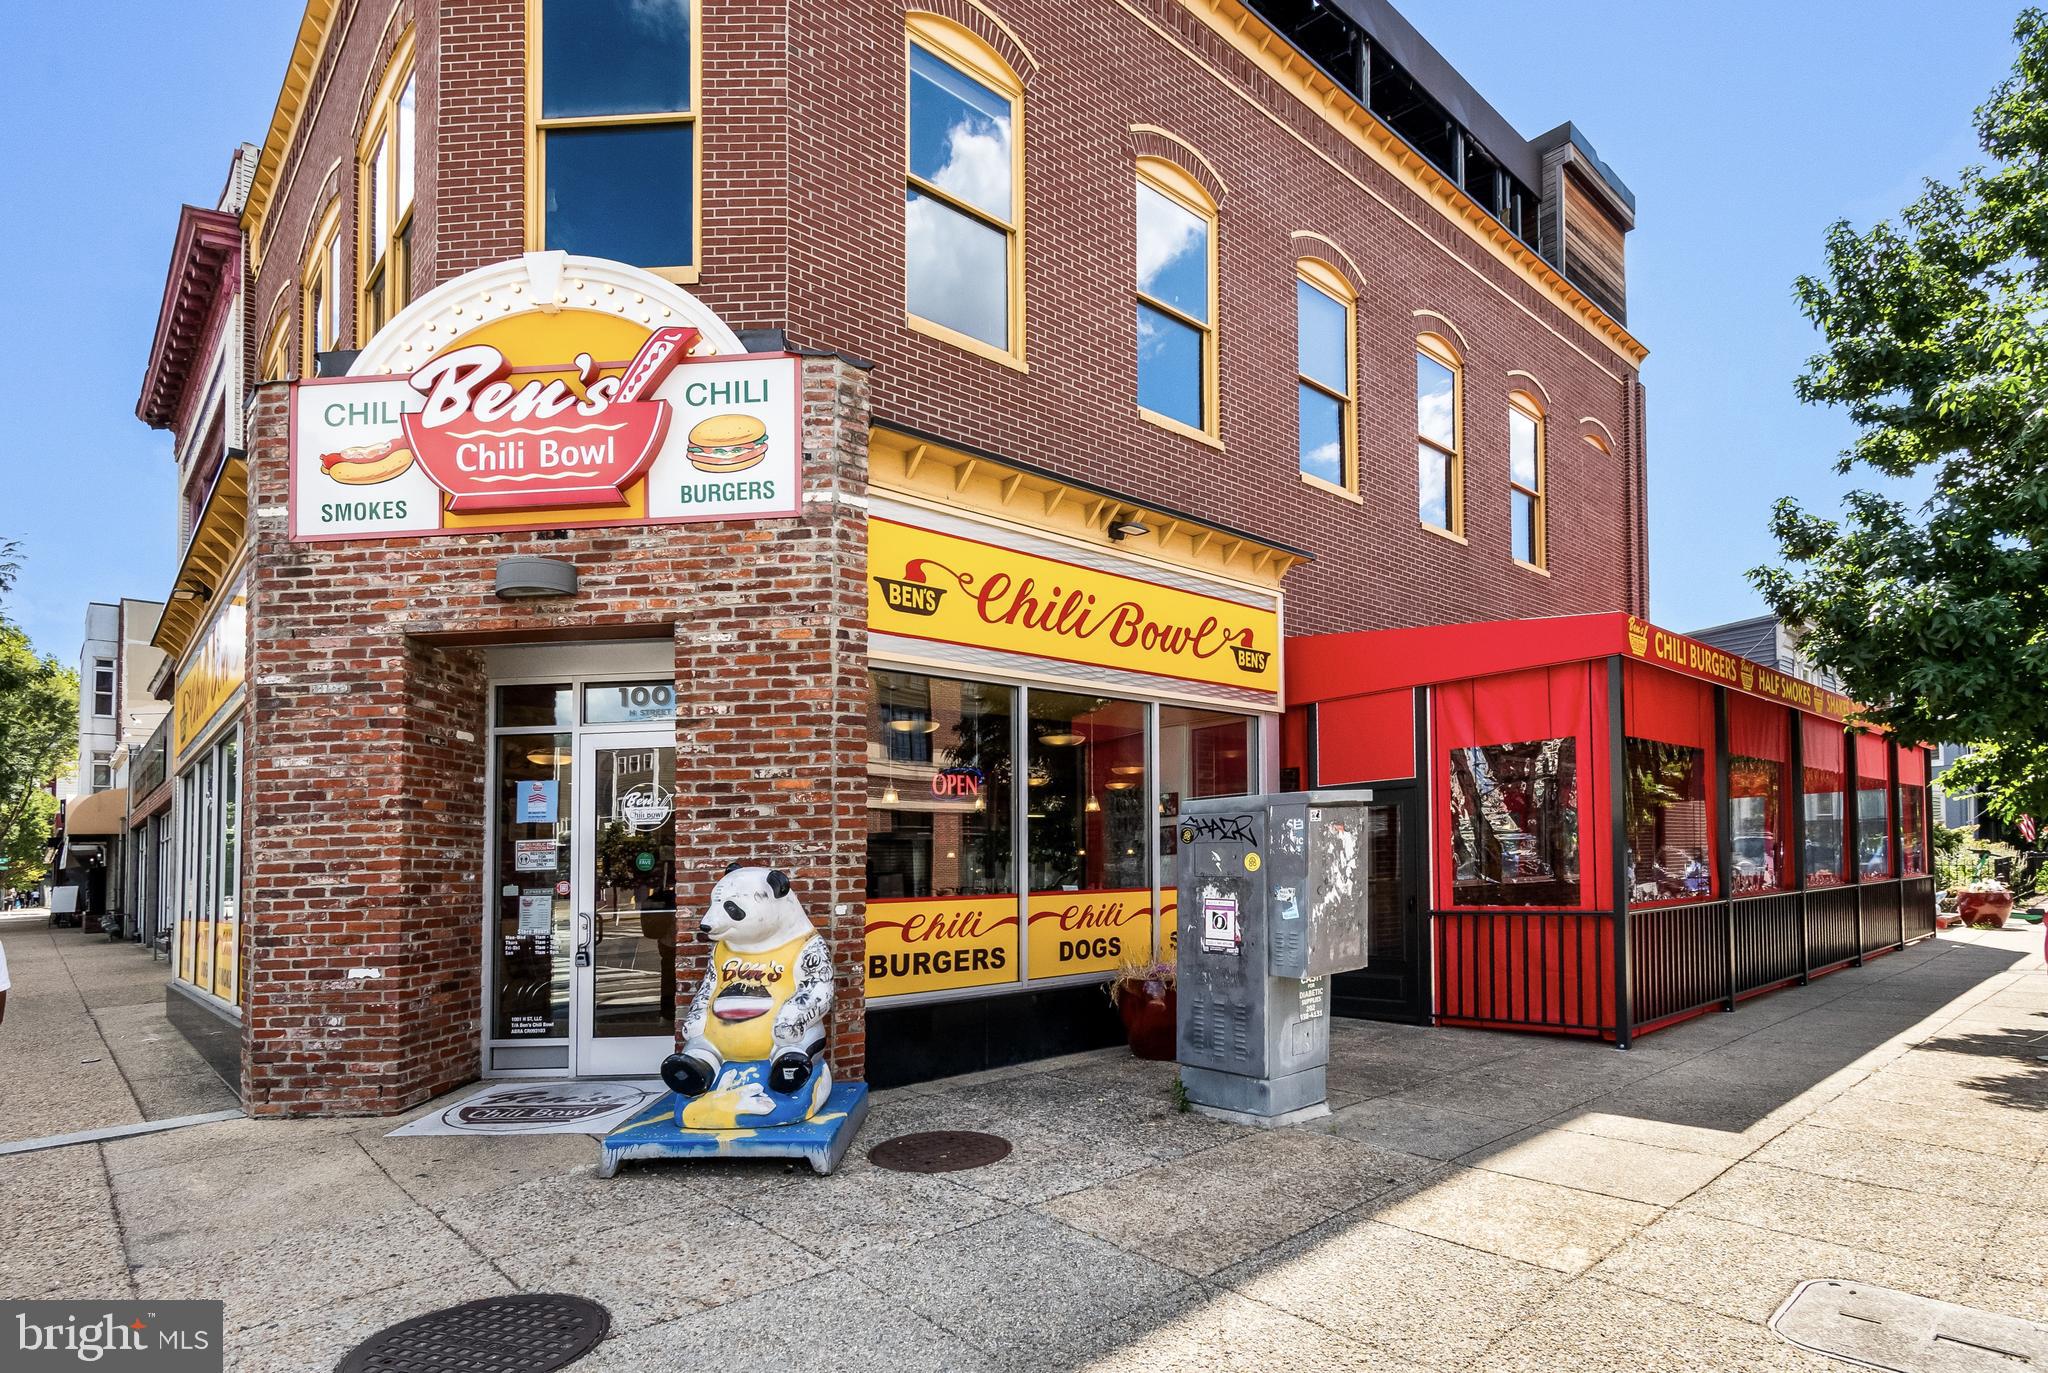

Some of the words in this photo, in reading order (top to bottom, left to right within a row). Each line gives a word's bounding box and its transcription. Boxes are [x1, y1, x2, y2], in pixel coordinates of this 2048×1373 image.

[408, 344, 622, 429] Ben's
[685, 378, 769, 408] CHILI
[323, 400, 405, 427] CHILI
[456, 441, 524, 472] Chili
[540, 437, 615, 468] Bowl
[680, 479, 775, 504] BURGERS
[320, 499, 408, 523] SMOKES
[888, 583, 936, 613] BEN'S
[976, 572, 1100, 639] Chili
[1108, 601, 1226, 659] Bowl
[1237, 651, 1266, 671] BEN'S
[1654, 631, 1687, 666] CHILI
[1689, 643, 1737, 682] BURGERS
[618, 685, 673, 709] 100
[1758, 669, 1780, 696] HALF
[1781, 677, 1811, 707] SMOKES
[640, 708, 672, 718] STREET
[932, 772, 979, 797] OPEN
[901, 910, 990, 944] Chili
[1059, 902, 1127, 932] Chili
[1058, 936, 1122, 962] DOGS
[868, 947, 1006, 979] BURGERS
[1299, 988, 1324, 998] DIABETIC
[1302, 996, 1322, 1005] SUPPLIES
[468, 1108, 526, 1119] Chili
[531, 1106, 597, 1118] Bowl
